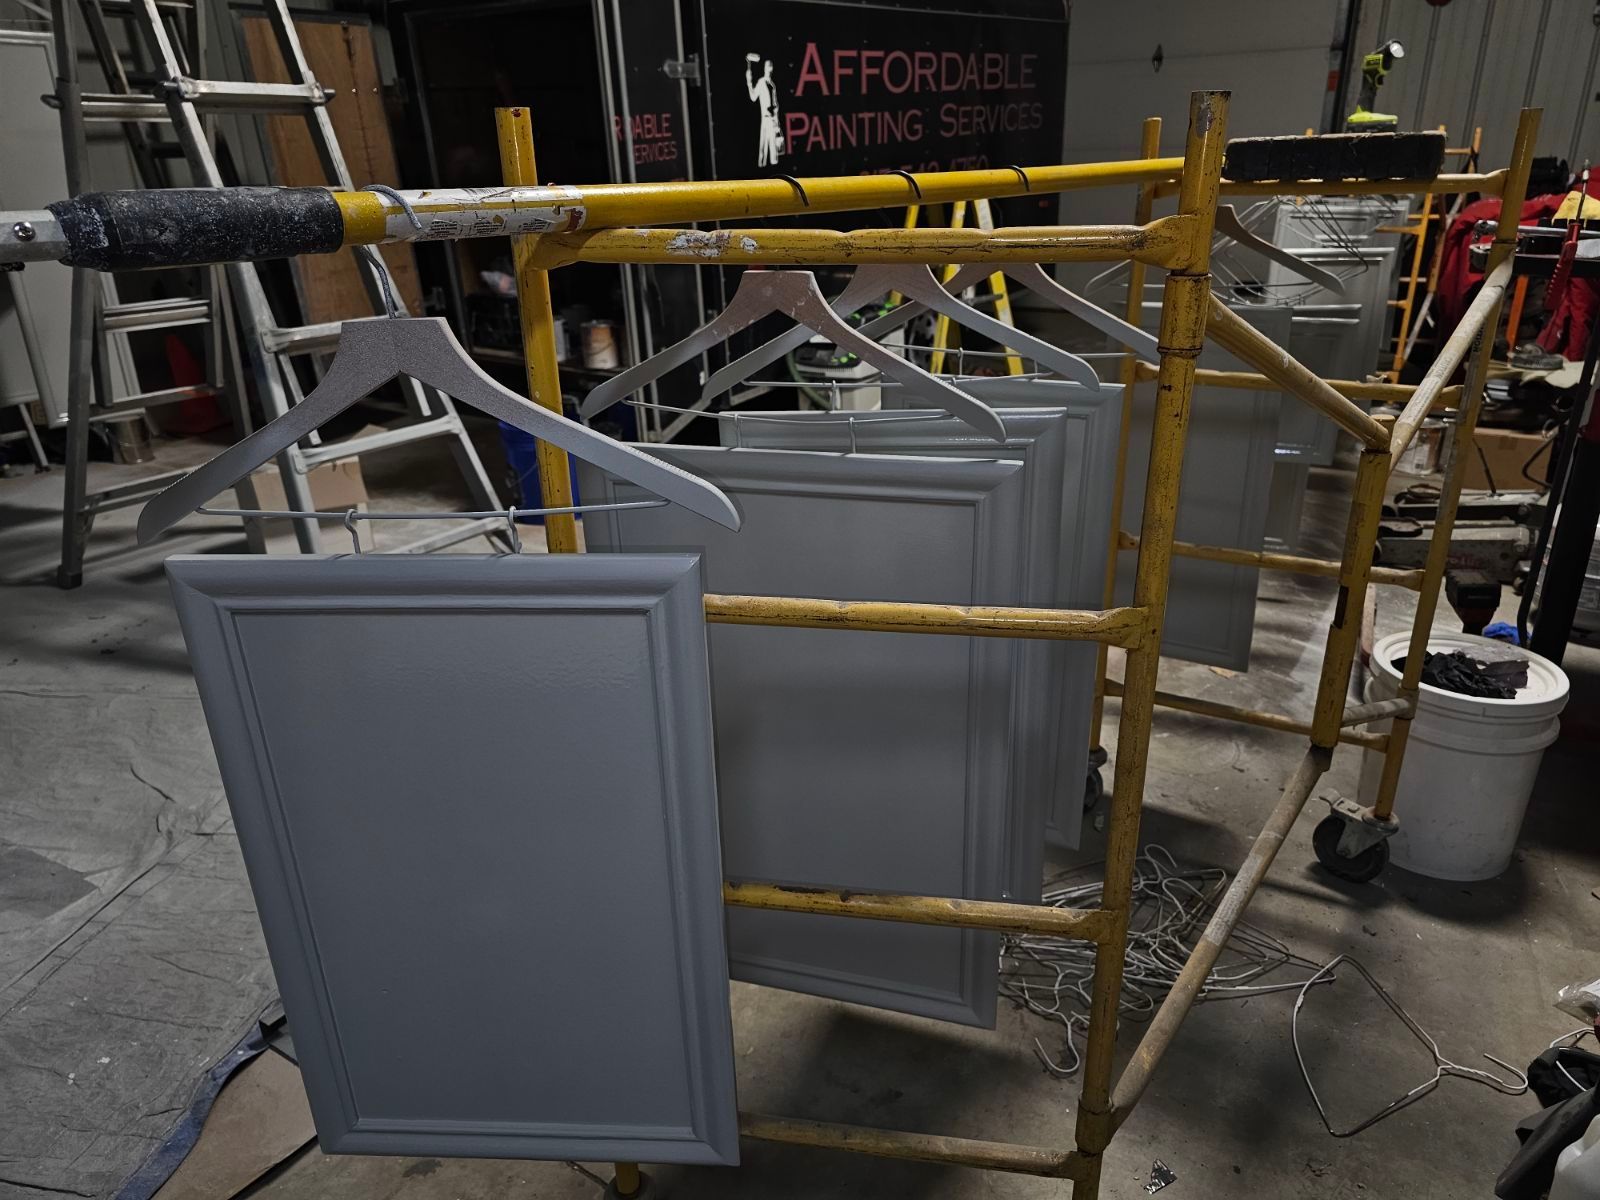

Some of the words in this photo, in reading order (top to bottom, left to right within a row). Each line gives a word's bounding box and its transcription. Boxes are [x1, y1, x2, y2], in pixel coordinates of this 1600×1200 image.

[794, 41, 1039, 98] AFFORDABLE
[783, 108, 924, 156] PAINTING
[940, 102, 1044, 138] SERVICES
